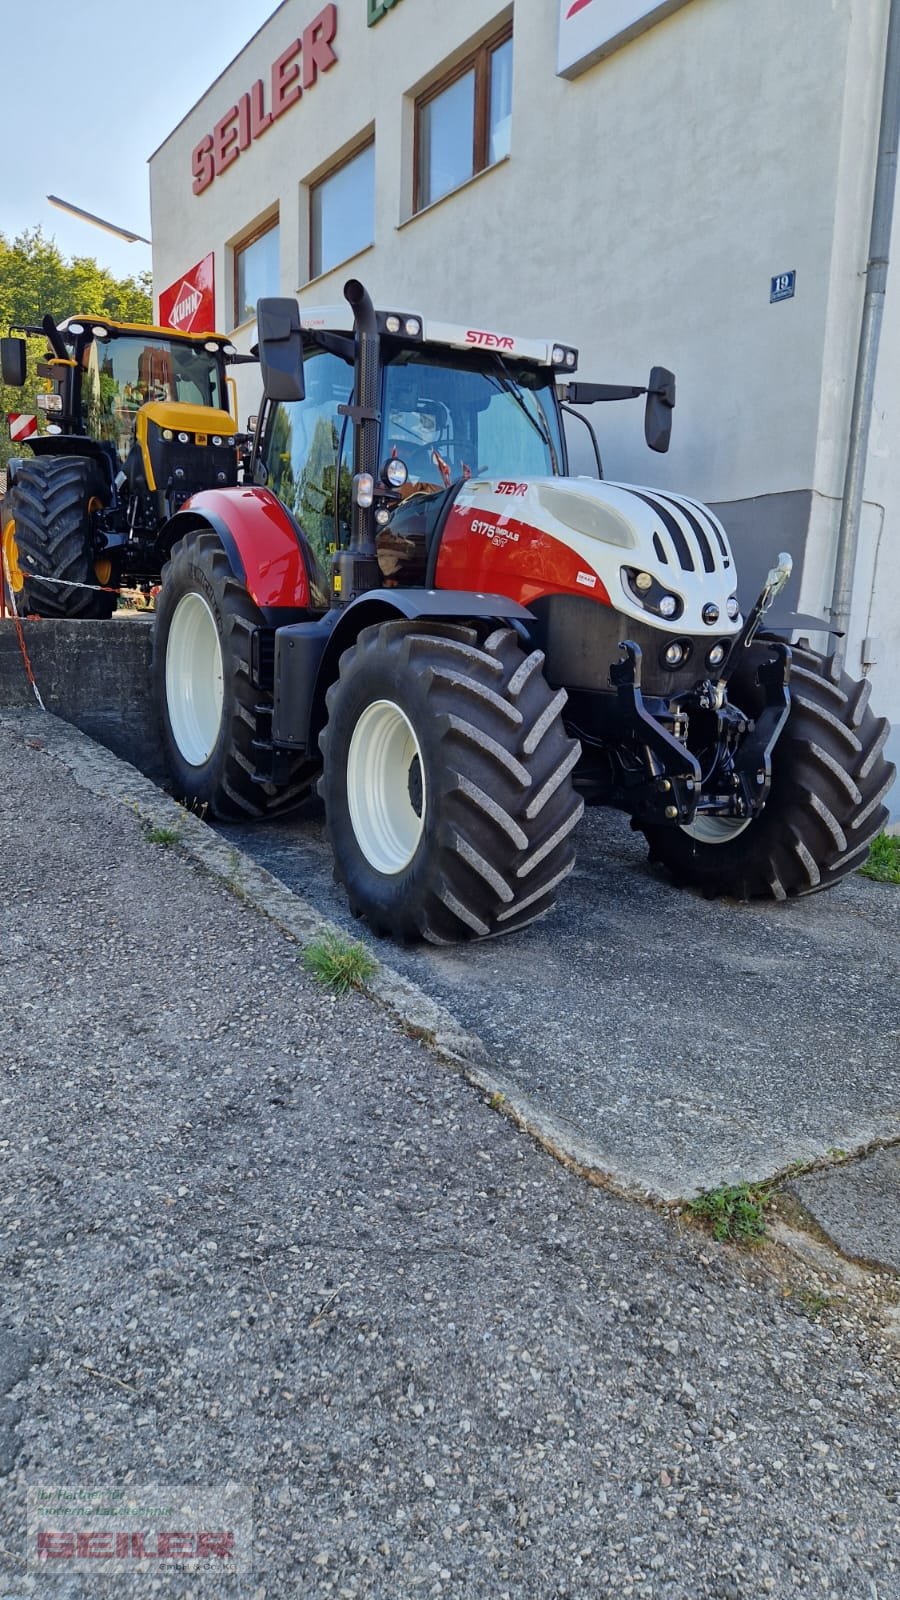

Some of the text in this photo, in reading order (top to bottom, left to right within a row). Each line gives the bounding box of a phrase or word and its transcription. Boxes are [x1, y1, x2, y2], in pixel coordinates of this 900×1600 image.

[192, 3, 338, 196] SEILER
[775, 274, 789, 292] 19
[172, 291, 198, 325] KUHN
[465, 330, 514, 350] STEYR
[494, 481, 528, 497] STEYR
[470, 519, 520, 542] 6175 IMPULS
